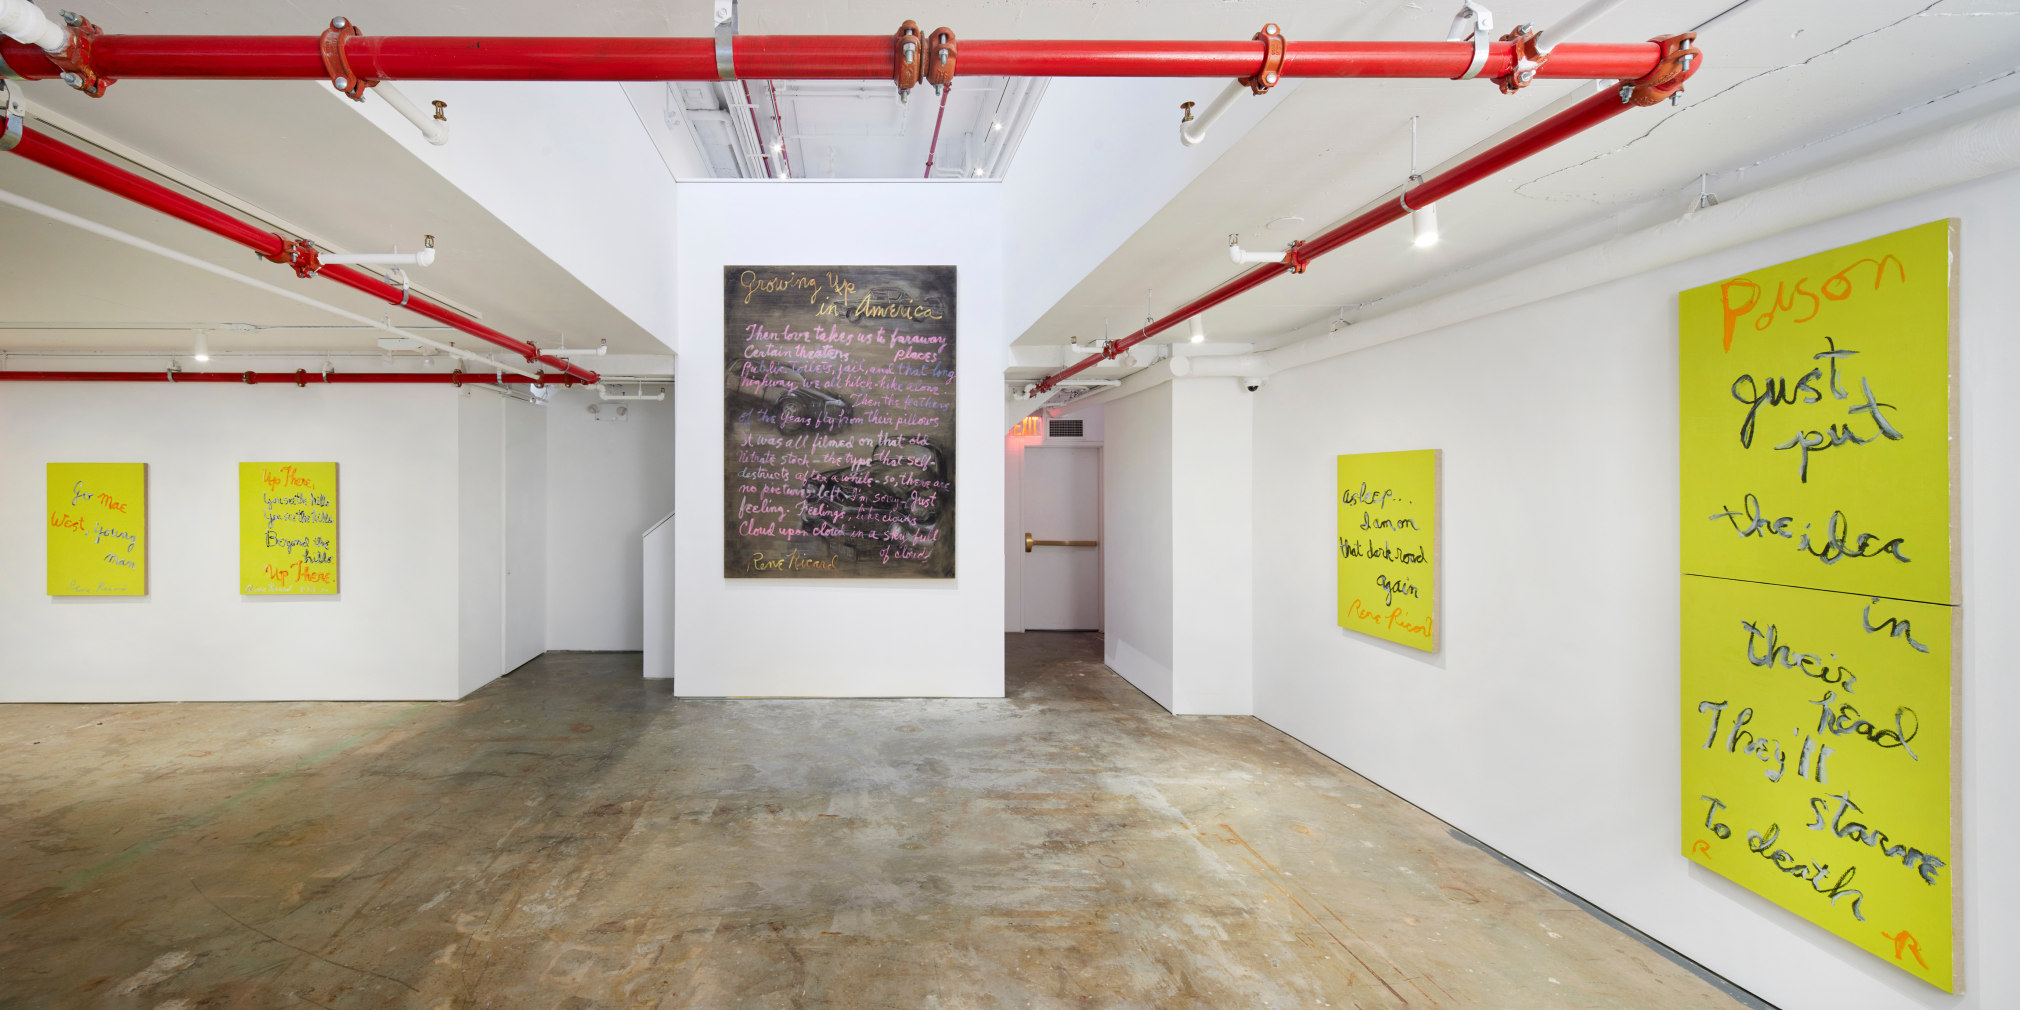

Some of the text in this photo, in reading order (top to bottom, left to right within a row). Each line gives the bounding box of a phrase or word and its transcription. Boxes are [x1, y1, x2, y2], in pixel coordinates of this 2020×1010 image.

[741, 270, 856, 307] Growing Up
[816, 294, 943, 320] in America
[745, 323, 780, 341] Then
[780, 324, 811, 343] love
[813, 324, 854, 346] takes
[857, 332, 873, 344] us
[890, 327, 948, 354] faraway
[823, 376, 842, 389] all
[869, 362, 895, 375] and
[896, 361, 928, 377] that
[931, 360, 957, 385] long
[849, 393, 880, 408] Then
[881, 393, 900, 408] the
[757, 407, 776, 424] the
[815, 410, 835, 432] fly
[894, 412, 939, 430] pillows
[1774, 376, 1904, 484] put
[757, 434, 783, 449] was
[785, 434, 809, 449] all
[811, 432, 854, 455] filmed
[858, 437, 874, 447] on
[877, 429, 904, 448] that
[908, 432, 930, 446] old
[822, 451, 842, 466] the
[845, 452, 873, 471] type
[873, 449, 903, 466] that
[738, 466, 789, 481] destructs
[899, 471, 931, 488] there
[739, 484, 757, 493] no
[778, 527, 809, 541] upon
[850, 526, 864, 539] in
[868, 529, 879, 540] a
[912, 527, 939, 546] full
[1397, 517, 1420, 531] on
[1709, 493, 1912, 566] the idea
[1376, 575, 1420, 607] again
[1862, 596, 1931, 653] in
[1741, 620, 1858, 694] their
[1698, 700, 1837, 784] They'll
[1747, 822, 1866, 923] death
